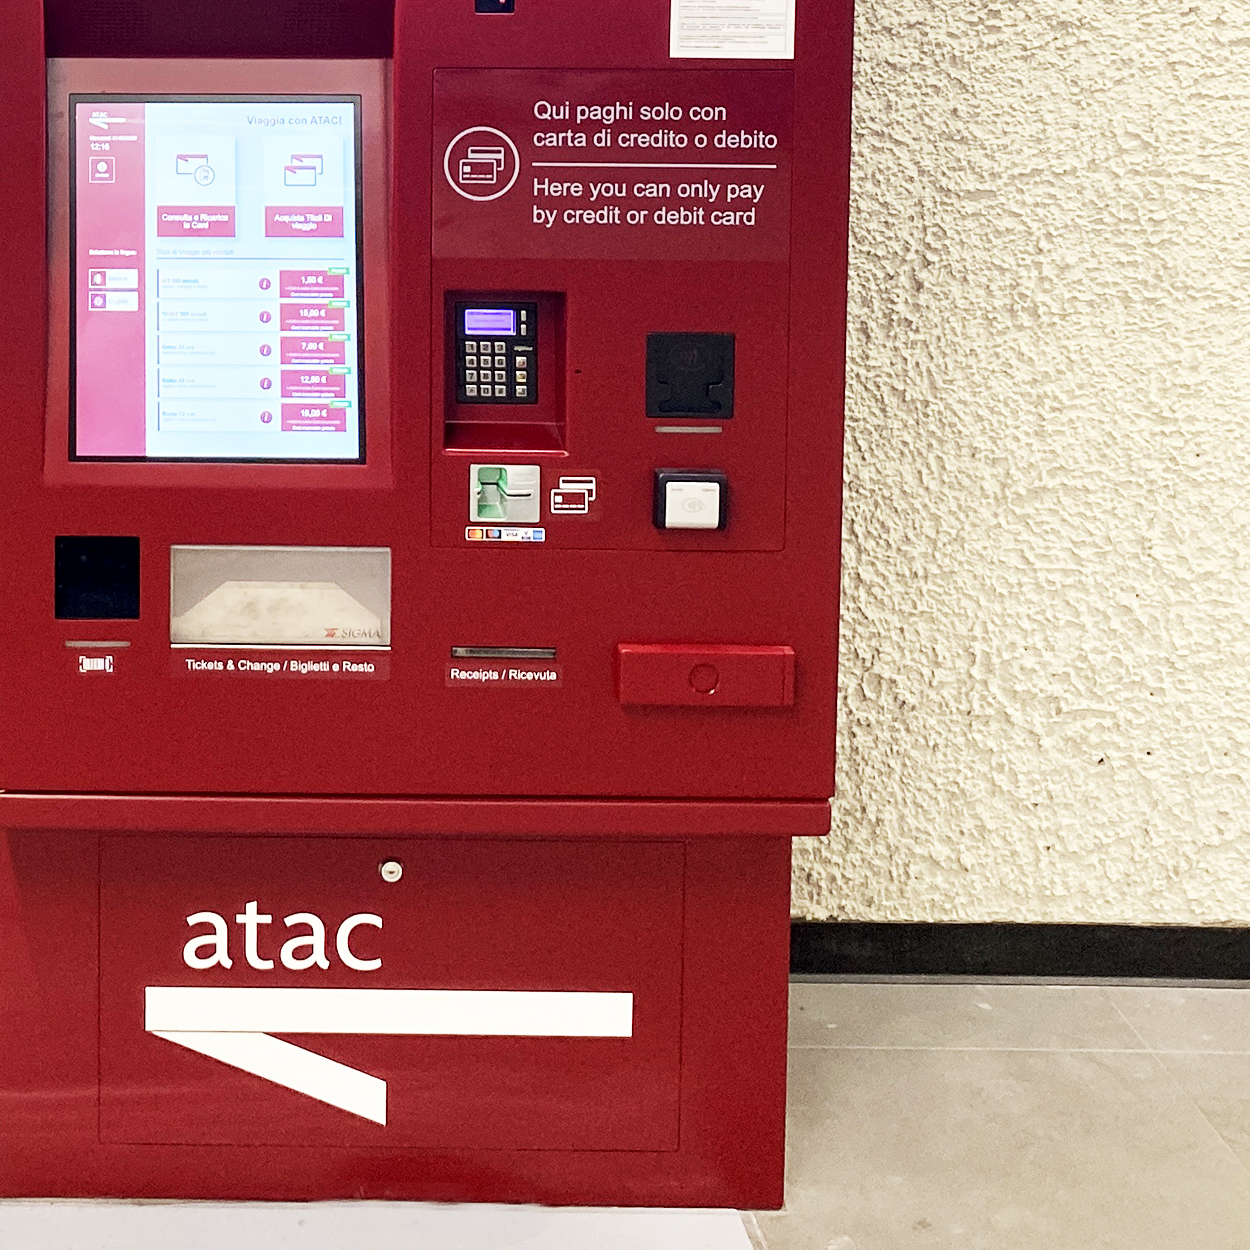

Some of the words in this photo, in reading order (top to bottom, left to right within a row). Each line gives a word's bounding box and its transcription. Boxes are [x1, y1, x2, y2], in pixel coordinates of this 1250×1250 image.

[247, 116, 284, 126] Viaggia
[534, 101, 569, 120] Qui
[577, 102, 632, 124] paghi
[640, 102, 682, 120] solo
[690, 107, 726, 120] con
[534, 130, 586, 146] carta
[594, 129, 610, 146] di
[618, 130, 687, 147] credito
[695, 134, 707, 147] o
[714, 130, 777, 148] debito
[534, 178, 582, 196] Here
[590, 183, 626, 201] you
[634, 184, 670, 197] can
[678, 180, 720, 202] only
[727, 185, 764, 202] pay
[533, 205, 557, 227] by
[564, 206, 620, 224] credit
[627, 211, 648, 224] or
[654, 207, 704, 224] debit
[711, 207, 755, 225] card
[341, 629, 381, 639] SIGMA
[186, 659, 223, 670] Tickets
[227, 660, 234, 670] &
[238, 660, 280, 673] Change
[290, 661, 329, 673] Biglietti
[343, 662, 374, 672] Resto
[451, 669, 499, 682] Receipts
[509, 670, 557, 680] Ricevuta
[184, 901, 382, 970] atac
